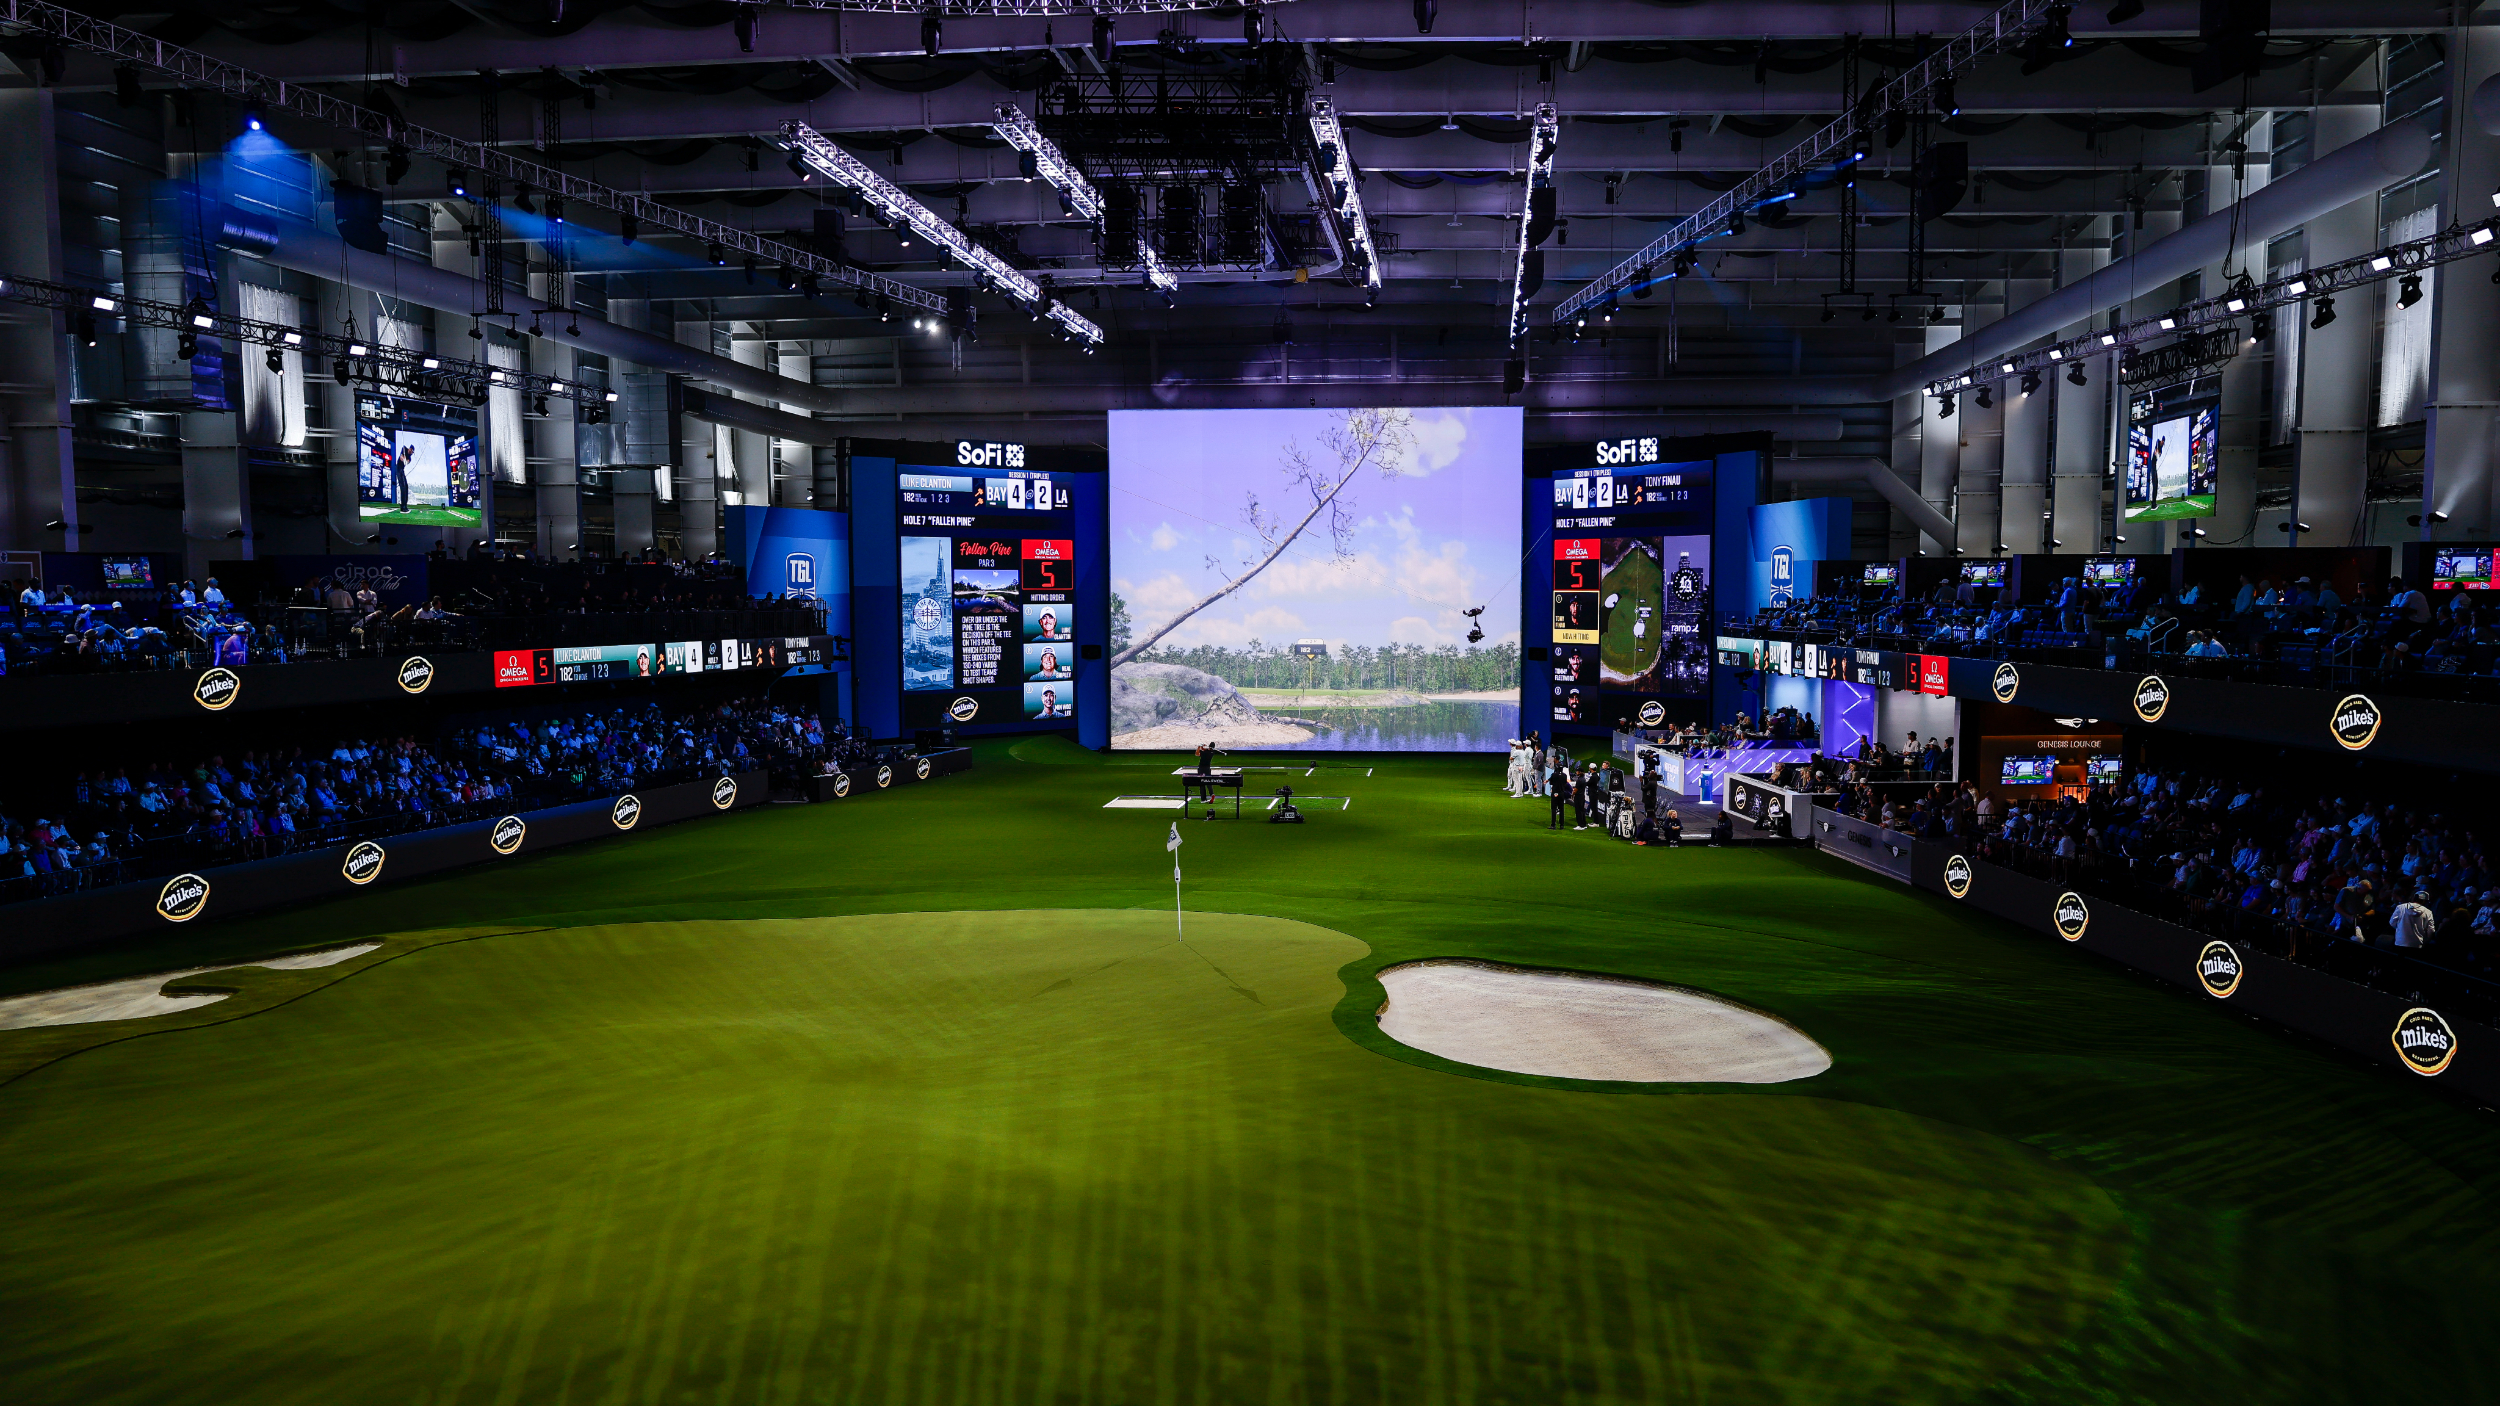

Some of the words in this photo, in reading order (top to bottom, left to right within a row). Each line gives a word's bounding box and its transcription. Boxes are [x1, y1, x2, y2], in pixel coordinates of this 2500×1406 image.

[958, 442, 1002, 466] SoFi
[1596, 439, 1636, 464] SoFi
[902, 477, 919, 487] LUKE
[920, 478, 952, 488] CLANTON
[1645, 475, 1661, 487] TONY
[1662, 475, 1681, 486] FINAU
[903, 493, 914, 502] 182
[931, 494, 934, 502] 1
[938, 494, 942, 503] 2
[945, 494, 950, 503] 3
[987, 486, 1006, 501] BAY
[1012, 485, 1020, 503] 4
[1039, 486, 1046, 503] 2
[1056, 489, 1068, 504] LA
[1555, 488, 1572, 502] BAY
[1577, 484, 1584, 502] 4
[1601, 483, 1608, 501] 2
[1616, 484, 1628, 499] LA
[1646, 492, 1656, 501] 182
[1671, 491, 1674, 500] 1
[1677, 491, 1681, 500] 2
[1684, 491, 1687, 500] 3
[904, 516, 920, 525] HOLE
[922, 516, 926, 525] 7
[1556, 519, 1570, 528] HOLE
[1570, 519, 1574, 528] 7
[960, 542, 988, 556] Fallen
[990, 542, 1012, 556] Pine
[335, 562, 392, 578] CÎROC
[790, 560, 812, 582] TGL
[1042, 562, 1054, 587] 5
[1570, 562, 1583, 588] 5
[1774, 554, 1790, 579] TGL
[1671, 624, 1691, 632] ramp
[785, 637, 796, 649] TONY
[556, 649, 573, 662] LUKE
[574, 648, 602, 661] CLANTON
[667, 646, 684, 665] BAY
[691, 648, 696, 665] 4
[728, 646, 732, 663] 2
[741, 643, 752, 660] LA
[787, 652, 796, 664] 182
[813, 650, 816, 661] 2
[817, 650, 820, 661] 3
[1770, 646, 1780, 664] BAY
[1784, 649, 1787, 667] 4
[1808, 652, 1812, 670] 2
[1819, 650, 1827, 670] LA
[1856, 650, 1866, 663] TONY
[403, 664, 428, 686] mike's
[500, 667, 528, 676] OMEGA
[540, 657, 548, 676] 5
[560, 666, 573, 681] 182
[592, 665, 595, 678] 1
[598, 664, 602, 678] 2
[604, 664, 608, 677] 3
[1911, 663, 1917, 683] 5
[1858, 668, 1866, 683] 182
[1882, 670, 1886, 685] 2
[1887, 671, 1890, 686] 3
[1925, 673, 1944, 684] OMEGA
[1996, 672, 2015, 690] mike's
[201, 678, 234, 698] mike's
[2139, 688, 2164, 707] mike's
[954, 703, 974, 714] mike's
[2338, 709, 2373, 732] mike's
[716, 784, 734, 800] mike's
[616, 802, 637, 821] mike's
[496, 823, 521, 845] mike's
[1848, 830, 1872, 848] GENESIS
[349, 851, 379, 874] mike's
[1948, 866, 1968, 882] mike's
[164, 884, 202, 910] mike's
[2059, 906, 2083, 923] mike's
[2203, 956, 2236, 976] mike's
[2401, 1026, 2447, 1049] mike's
